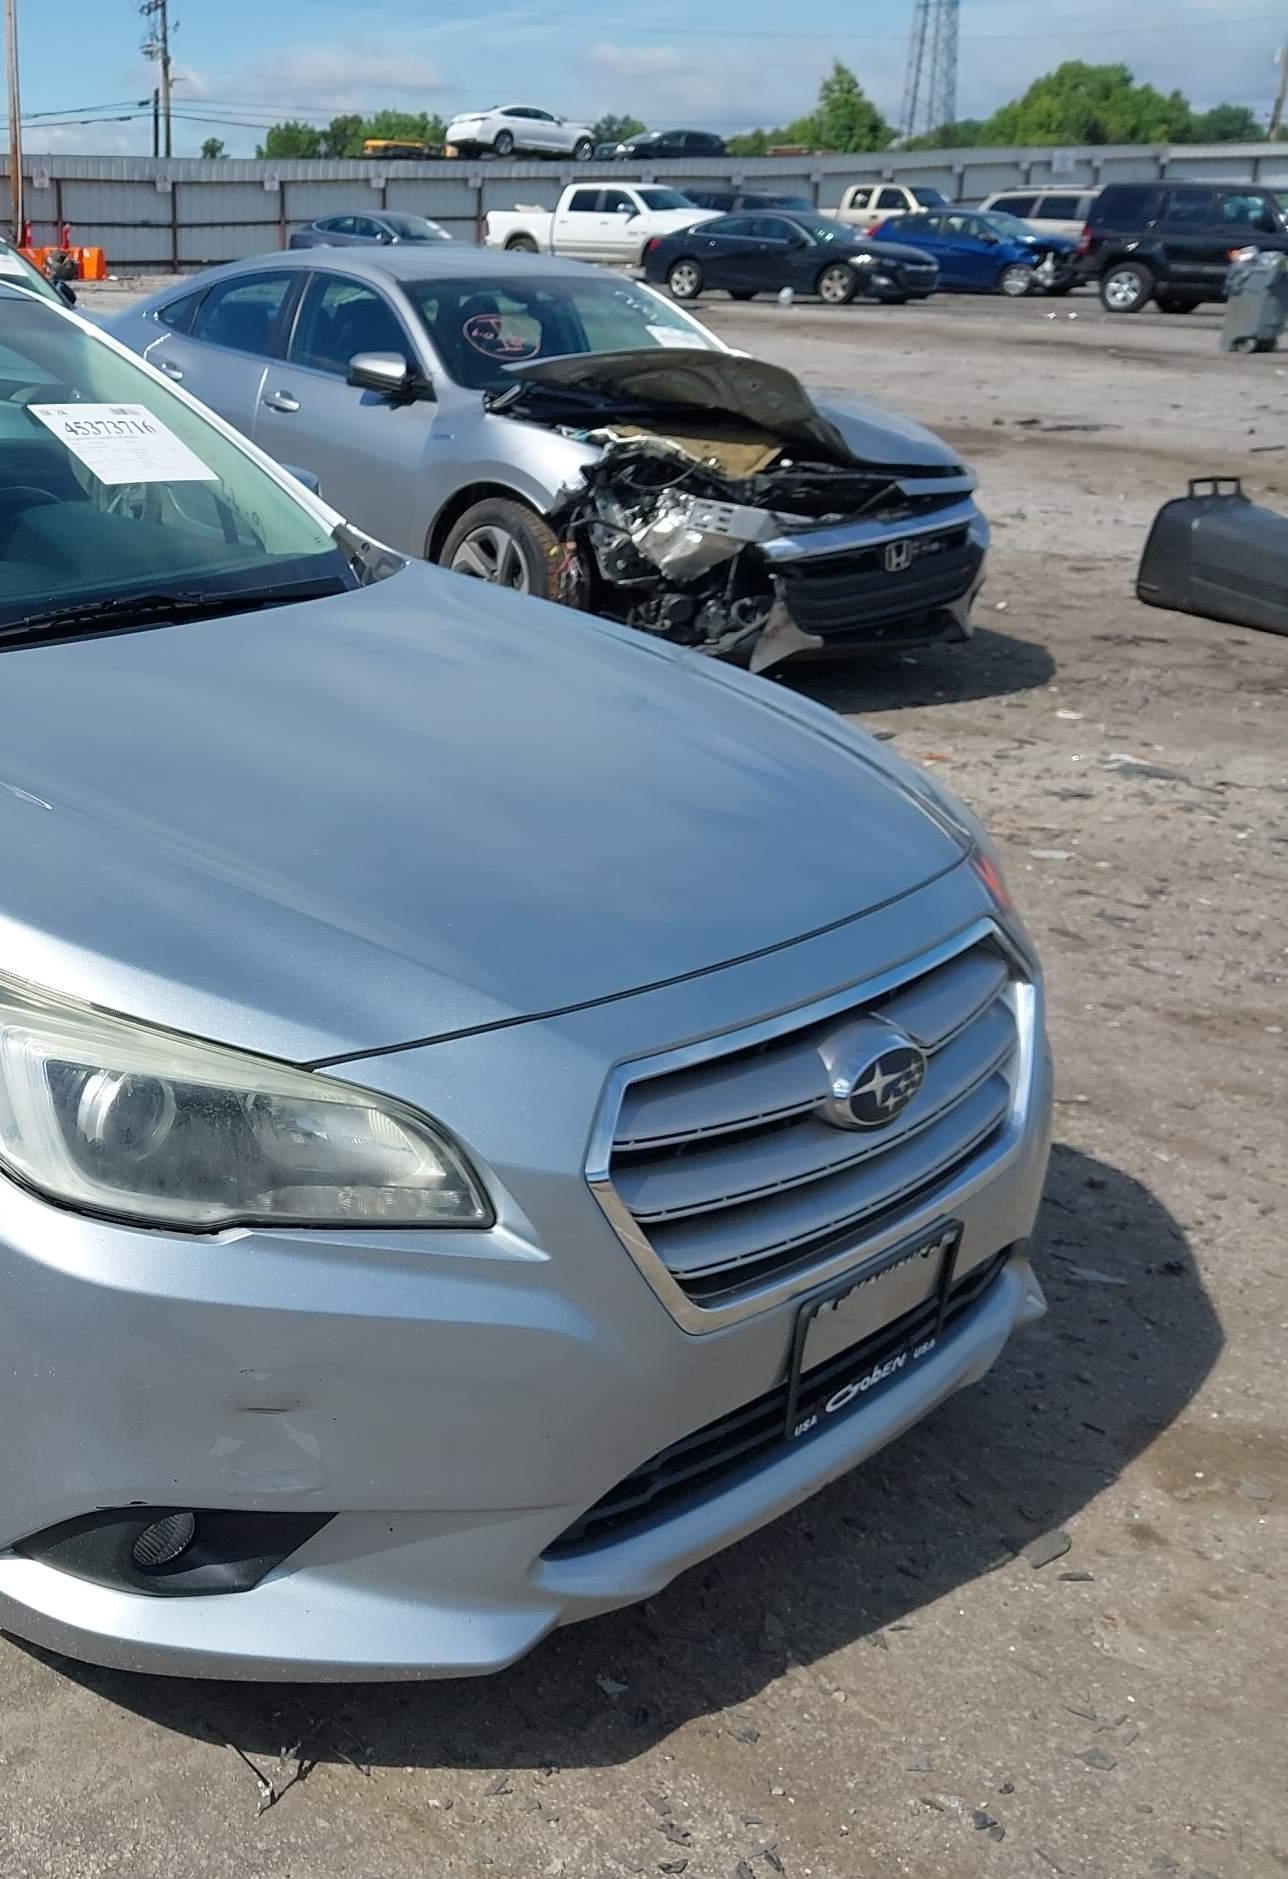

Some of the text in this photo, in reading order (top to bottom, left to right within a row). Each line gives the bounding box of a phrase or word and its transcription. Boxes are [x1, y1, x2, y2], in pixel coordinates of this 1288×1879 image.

[65, 420, 156, 436] 45373716
[794, 1415, 817, 1436] USA
[913, 1339, 935, 1358] USA
